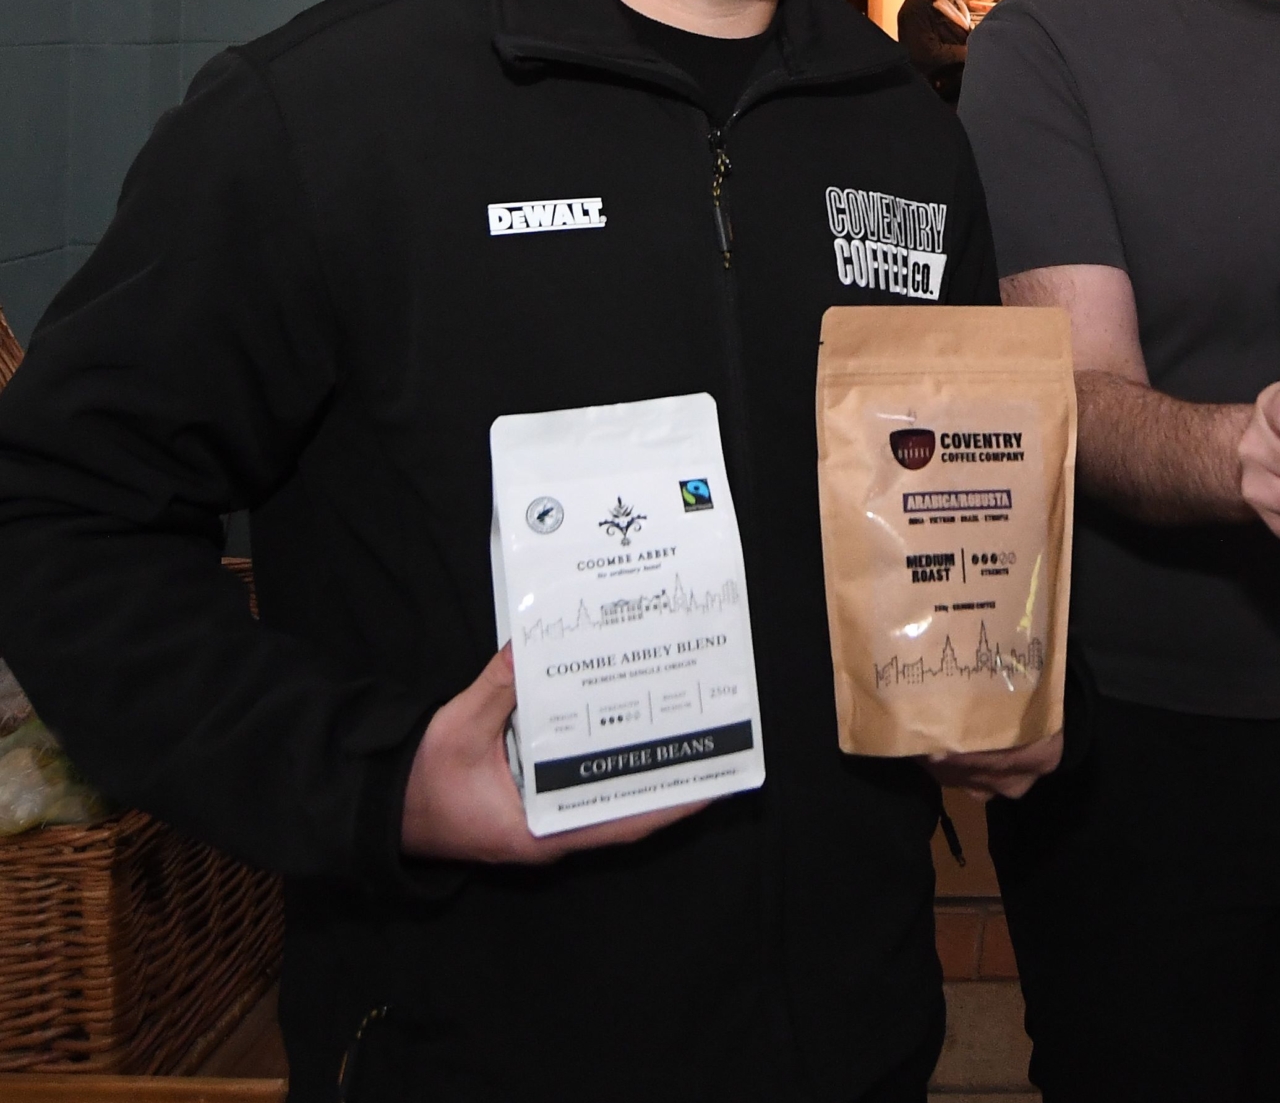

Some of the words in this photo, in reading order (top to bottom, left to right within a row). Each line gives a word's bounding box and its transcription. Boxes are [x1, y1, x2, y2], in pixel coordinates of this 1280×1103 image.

[825, 186, 947, 253] COVENTRY
[833, 238, 908, 295] COFFEE
[940, 432, 1023, 450] COVENTRY
[941, 452, 977, 463] COFFEE
[979, 451, 1025, 462] COMPANY
[577, 554, 632, 571] COOMBE
[638, 546, 676, 561] ABBEY
[906, 553, 955, 569] MEDIUM
[912, 568, 950, 584] ROAST
[546, 654, 617, 678] COOMBE
[621, 644, 672, 665] ABBEY
[677, 634, 727, 654] BLEND
[710, 685, 738, 700] 250g
[579, 749, 651, 778] COFFEE
[657, 736, 715, 761] BEANS
